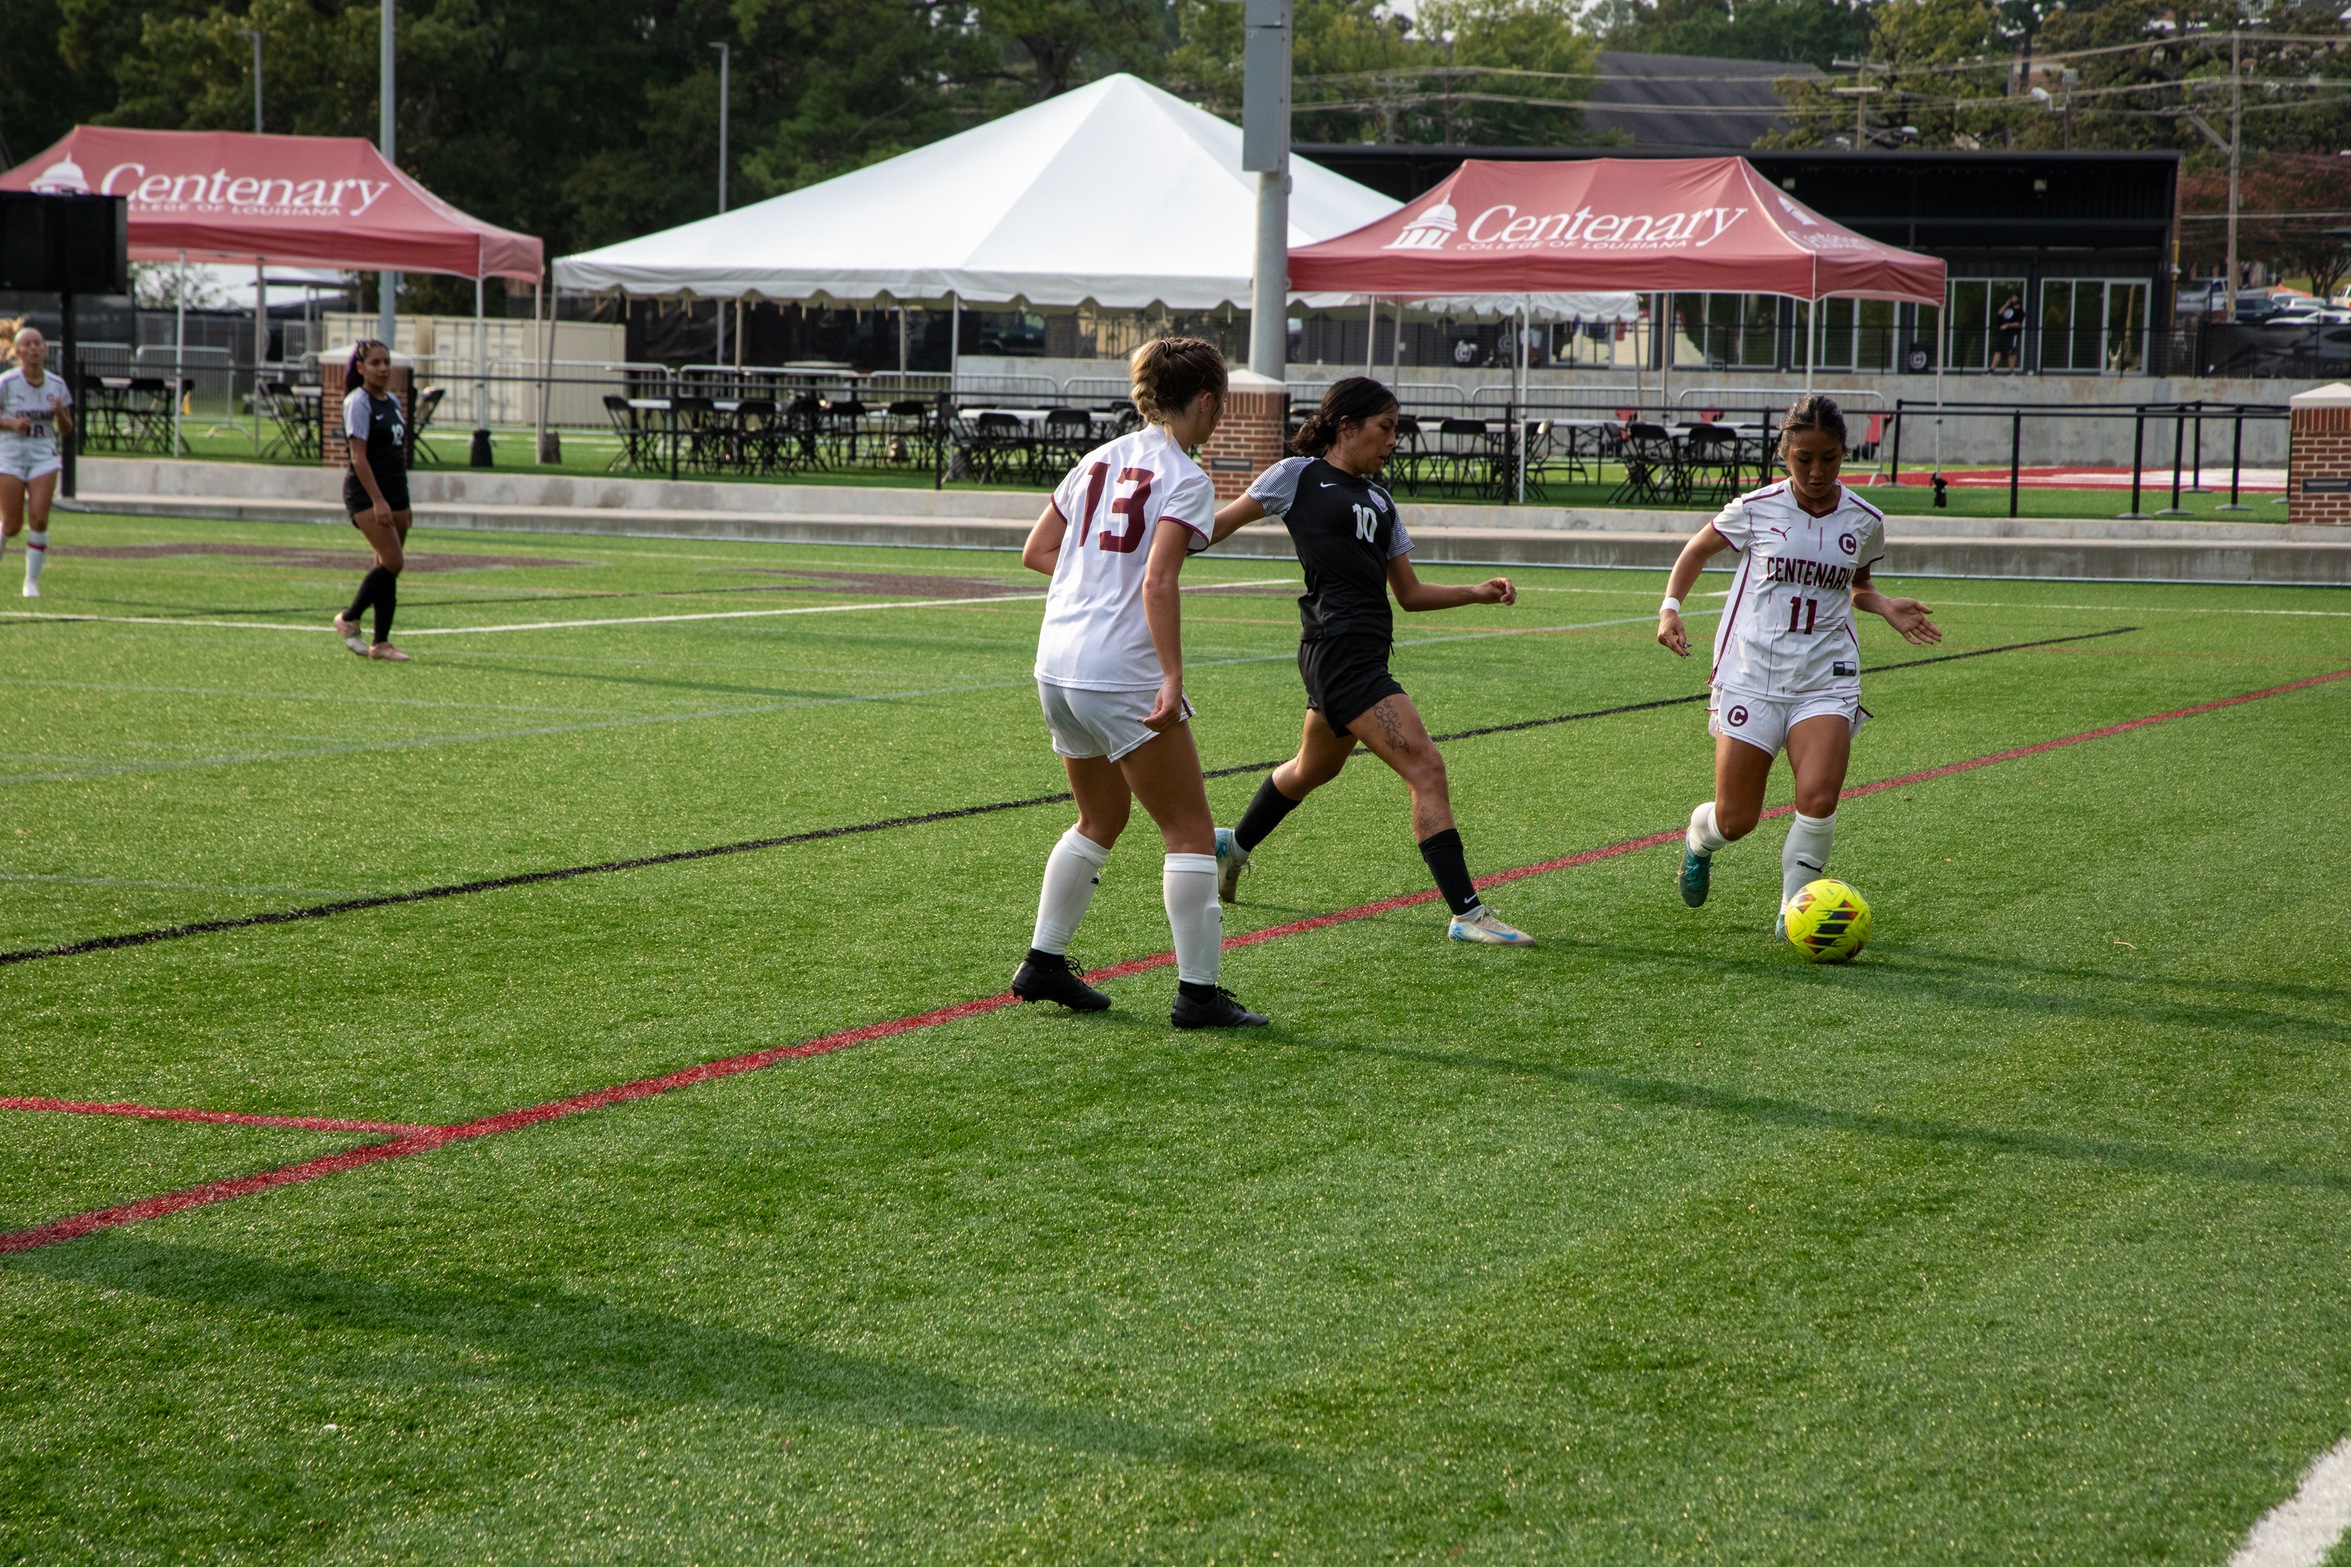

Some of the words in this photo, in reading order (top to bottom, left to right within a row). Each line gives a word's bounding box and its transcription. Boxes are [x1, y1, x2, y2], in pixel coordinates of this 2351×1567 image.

[101, 162, 390, 216] Centenary
[231, 205, 341, 217] LOUISIANA
[1467, 203, 1748, 246] Centenary
[1456, 241, 1544, 250] COLLEGE
[1549, 240, 1578, 249] OF
[1582, 239, 1687, 250] LOUISIANA
[1079, 461, 1155, 553] 13
[1352, 503, 1378, 543] 10
[1766, 557, 1854, 590] CENTENARY
[1788, 596, 1817, 635] 11
[1729, 706, 1747, 726] C
